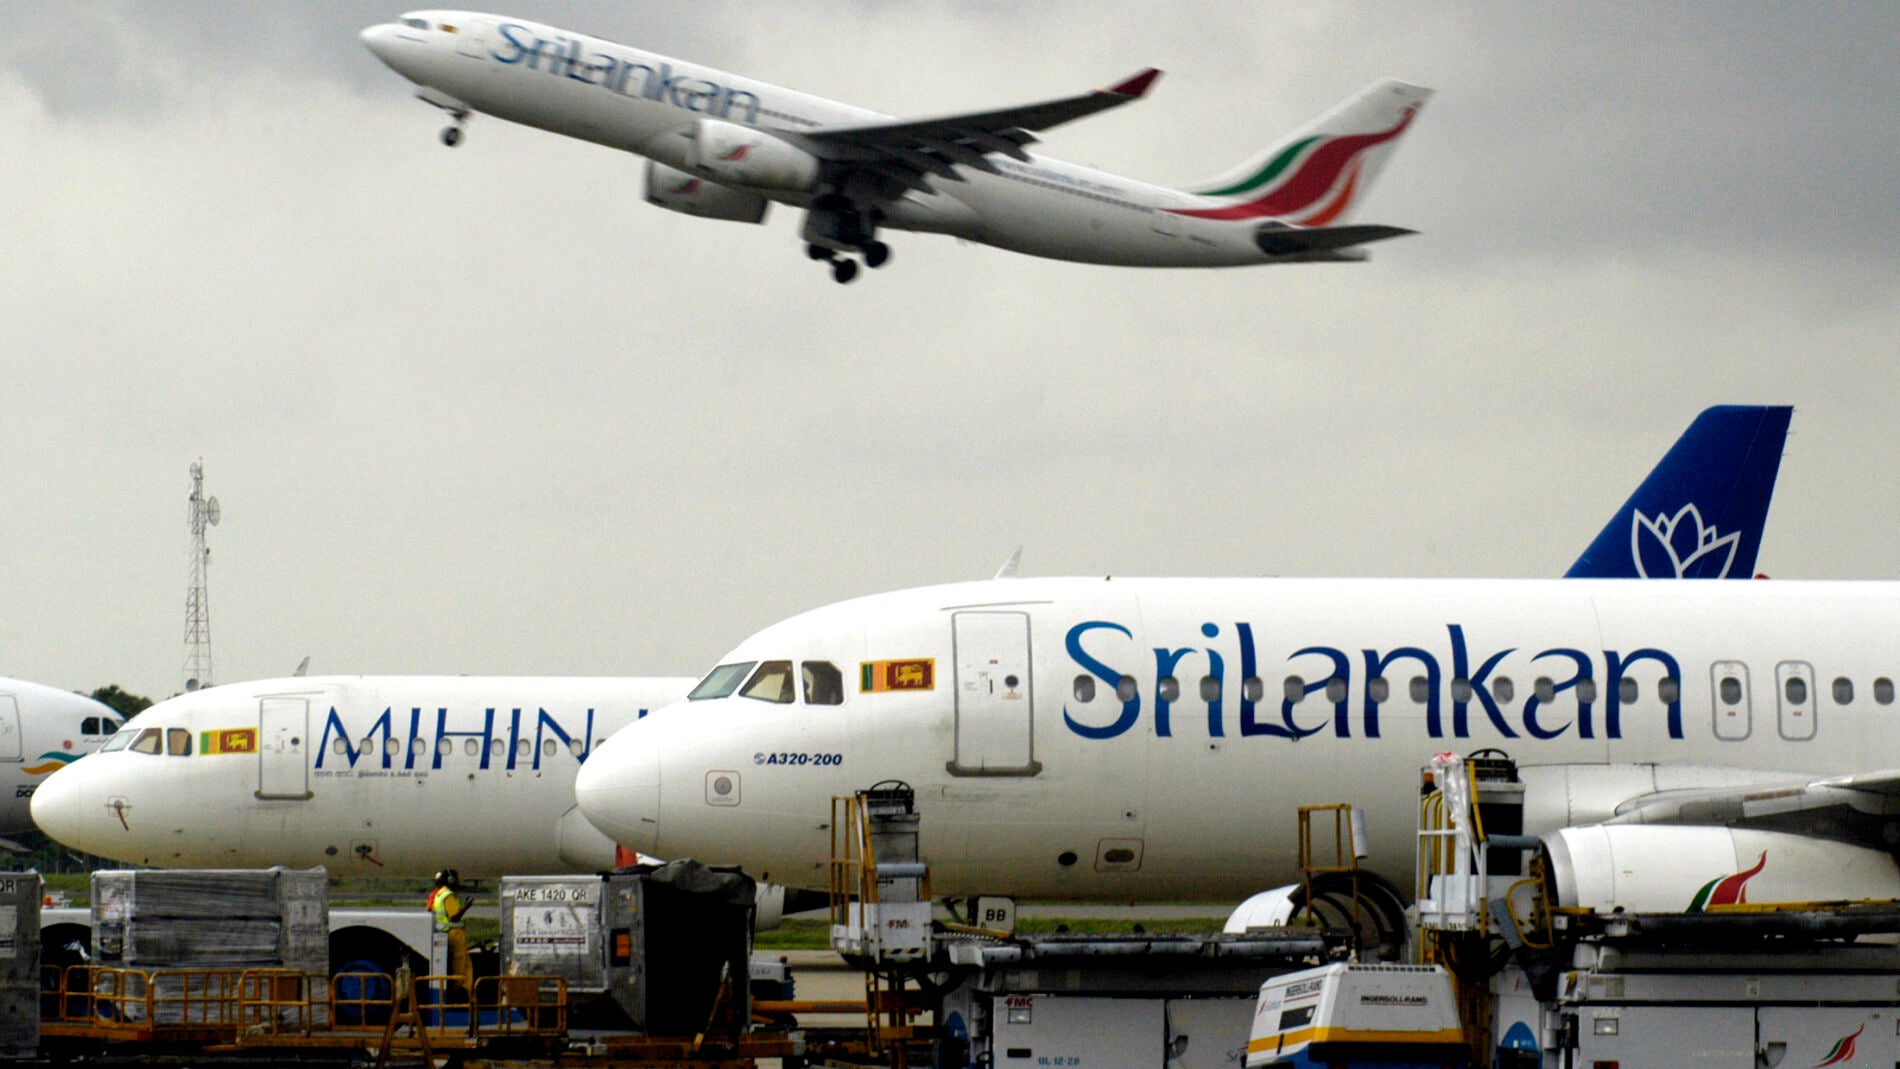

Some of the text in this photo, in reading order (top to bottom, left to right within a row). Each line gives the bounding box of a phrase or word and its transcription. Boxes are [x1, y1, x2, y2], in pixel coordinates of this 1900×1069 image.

[491, 23, 760, 123] SriLankan
[1063, 620, 1683, 739] SriLankan
[314, 706, 595, 770] MIHIN
[766, 752, 843, 766] A320-200
[516, 889, 537, 901] AKE
[541, 889, 566, 901] 1420
